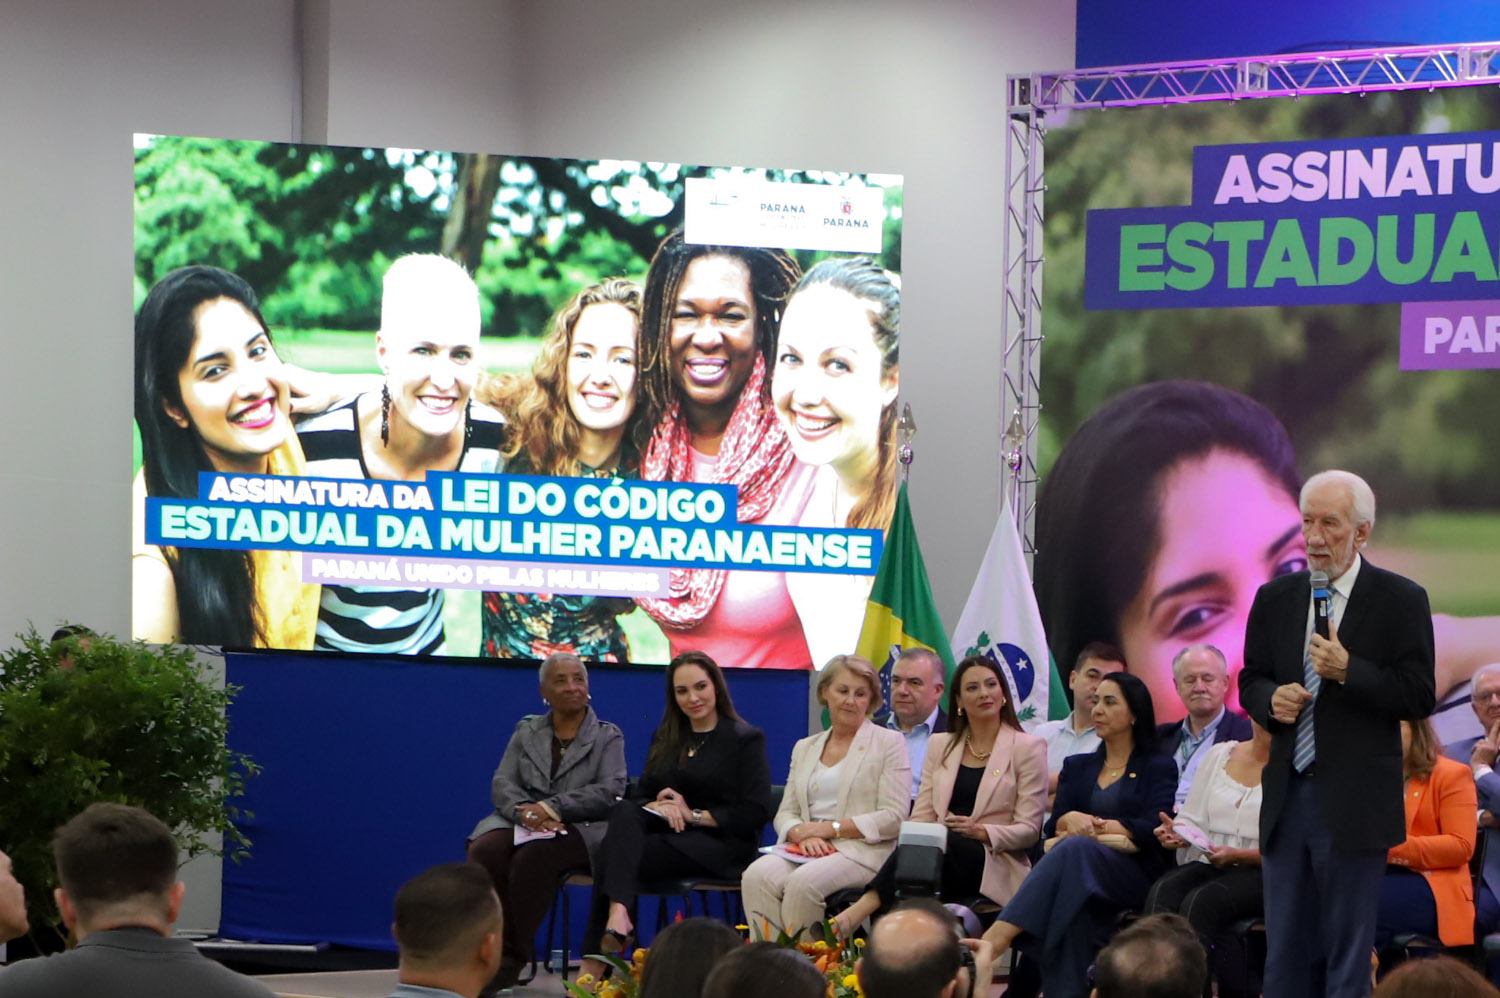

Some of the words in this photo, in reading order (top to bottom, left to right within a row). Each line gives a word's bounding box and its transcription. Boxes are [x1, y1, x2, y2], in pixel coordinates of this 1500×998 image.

[208, 477, 388, 511] ASSINATURA
[392, 482, 434, 511] DA
[441, 478, 499, 513] LEI
[508, 483, 566, 516] DO
[574, 477, 725, 522] CÓDIGO
[160, 505, 368, 547] ESTADUAL
[375, 514, 433, 549] DA
[440, 518, 602, 560] MULHER
[609, 527, 872, 568] PARANAENSE
[312, 558, 401, 581] PARANÁ
[405, 564, 473, 584] UNIDO
[476, 567, 544, 587] PELAS
[547, 569, 660, 592] MULHERES
